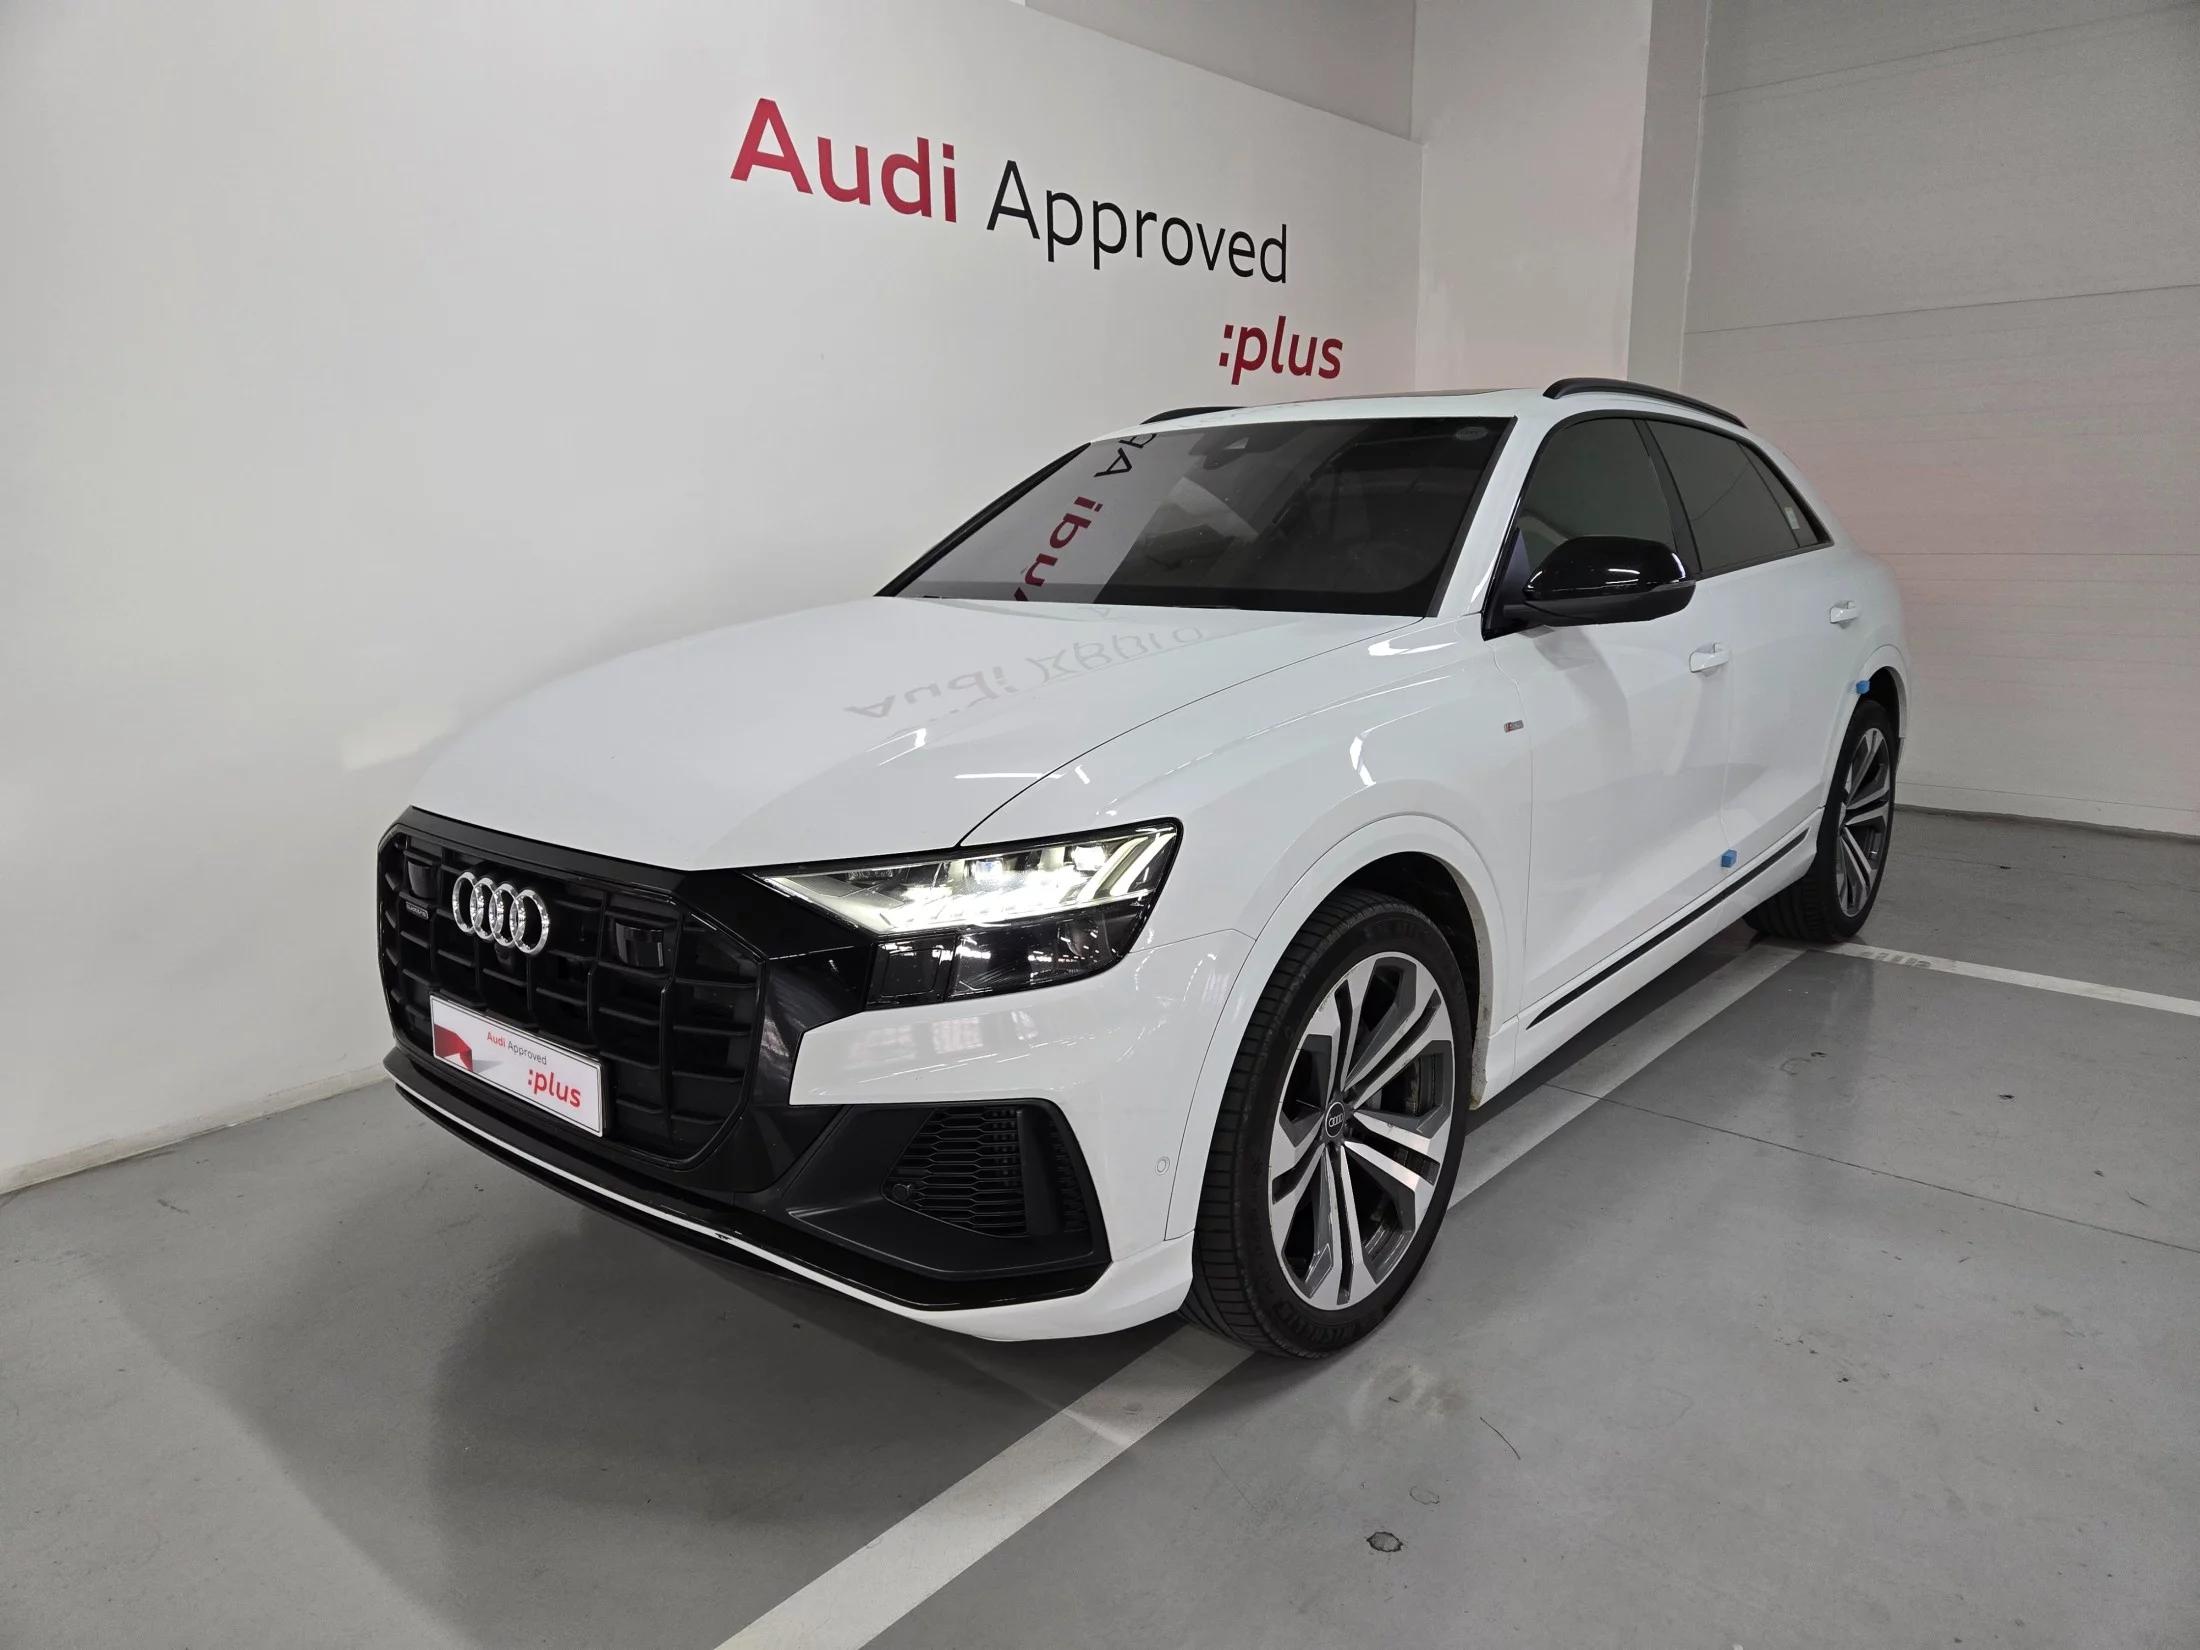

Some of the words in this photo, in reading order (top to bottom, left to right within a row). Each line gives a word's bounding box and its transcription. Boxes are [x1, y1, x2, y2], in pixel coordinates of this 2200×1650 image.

[730, 97, 956, 223] Audi
[986, 159, 1287, 284] Approved
[1218, 315, 1343, 385] :plus
[487, 1032, 506, 1048] Audi
[508, 1040, 547, 1065] Approved
[528, 1069, 581, 1108] :plus
